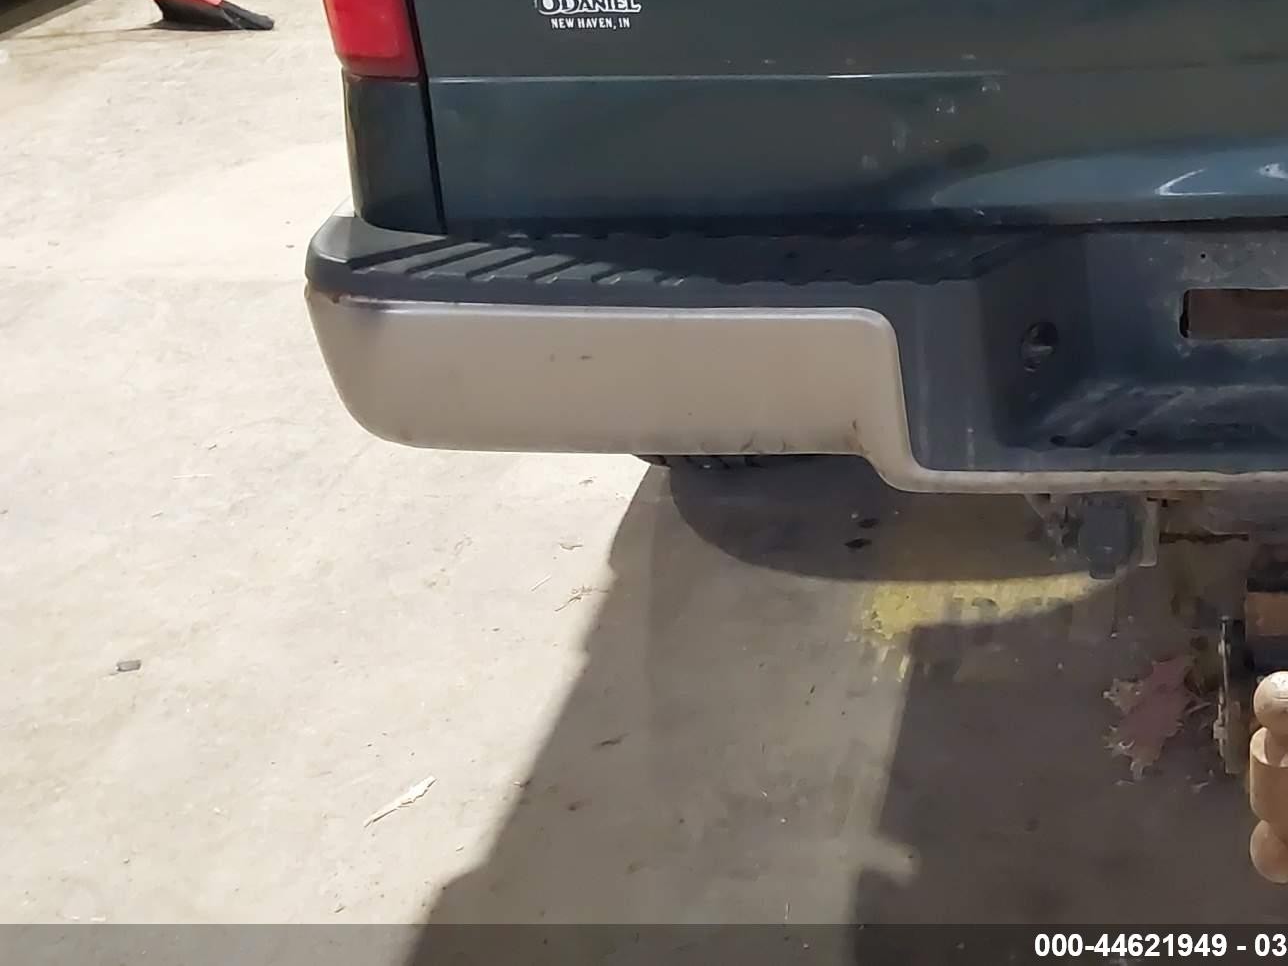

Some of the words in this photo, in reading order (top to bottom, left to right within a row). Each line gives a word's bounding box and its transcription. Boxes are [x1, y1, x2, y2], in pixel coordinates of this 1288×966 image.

[550, 17, 574, 29] NEW
[577, 17, 617, 30] HAVEN,
[618, 17, 630, 28] IN
